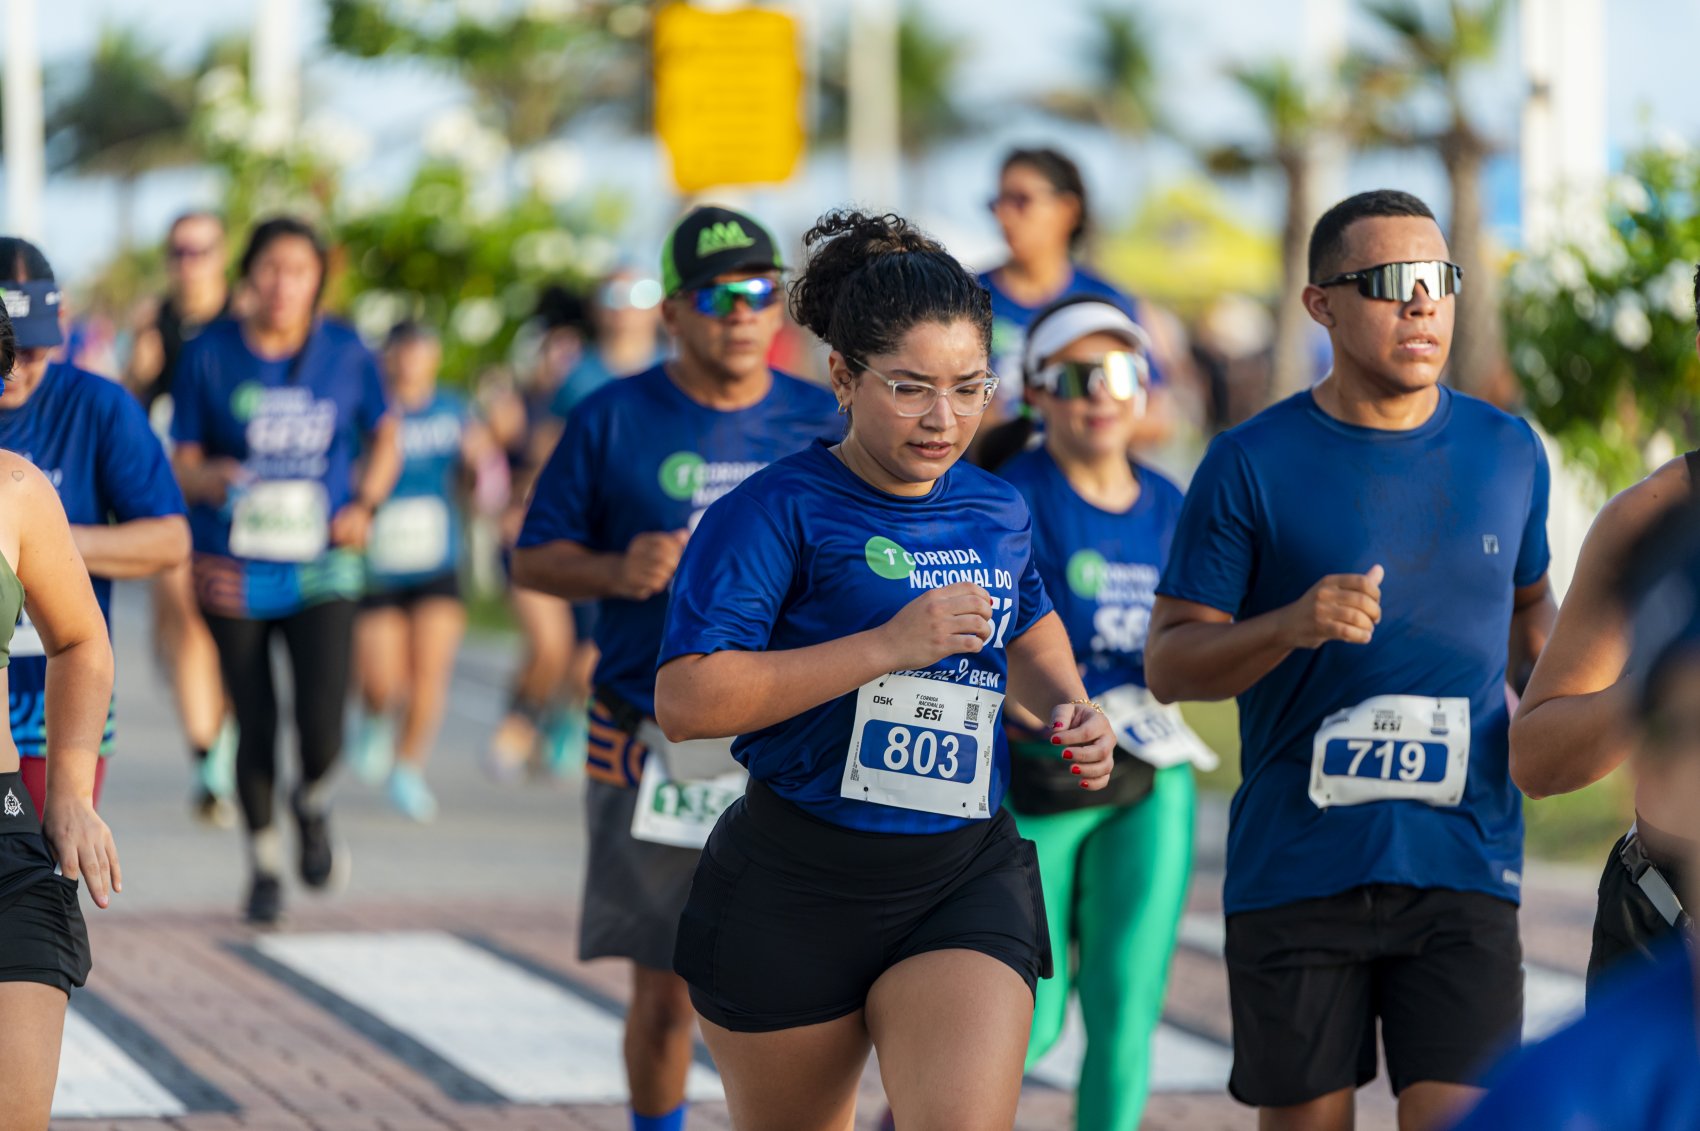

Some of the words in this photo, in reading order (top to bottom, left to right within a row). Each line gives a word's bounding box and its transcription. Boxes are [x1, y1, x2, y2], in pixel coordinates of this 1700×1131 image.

[903, 548, 982, 567] CORRIDA
[909, 568, 993, 589] NACIONAL
[995, 568, 1013, 590] DO
[969, 669, 1001, 689] BEM
[883, 726, 960, 780] 803
[1347, 740, 1426, 782] 719
